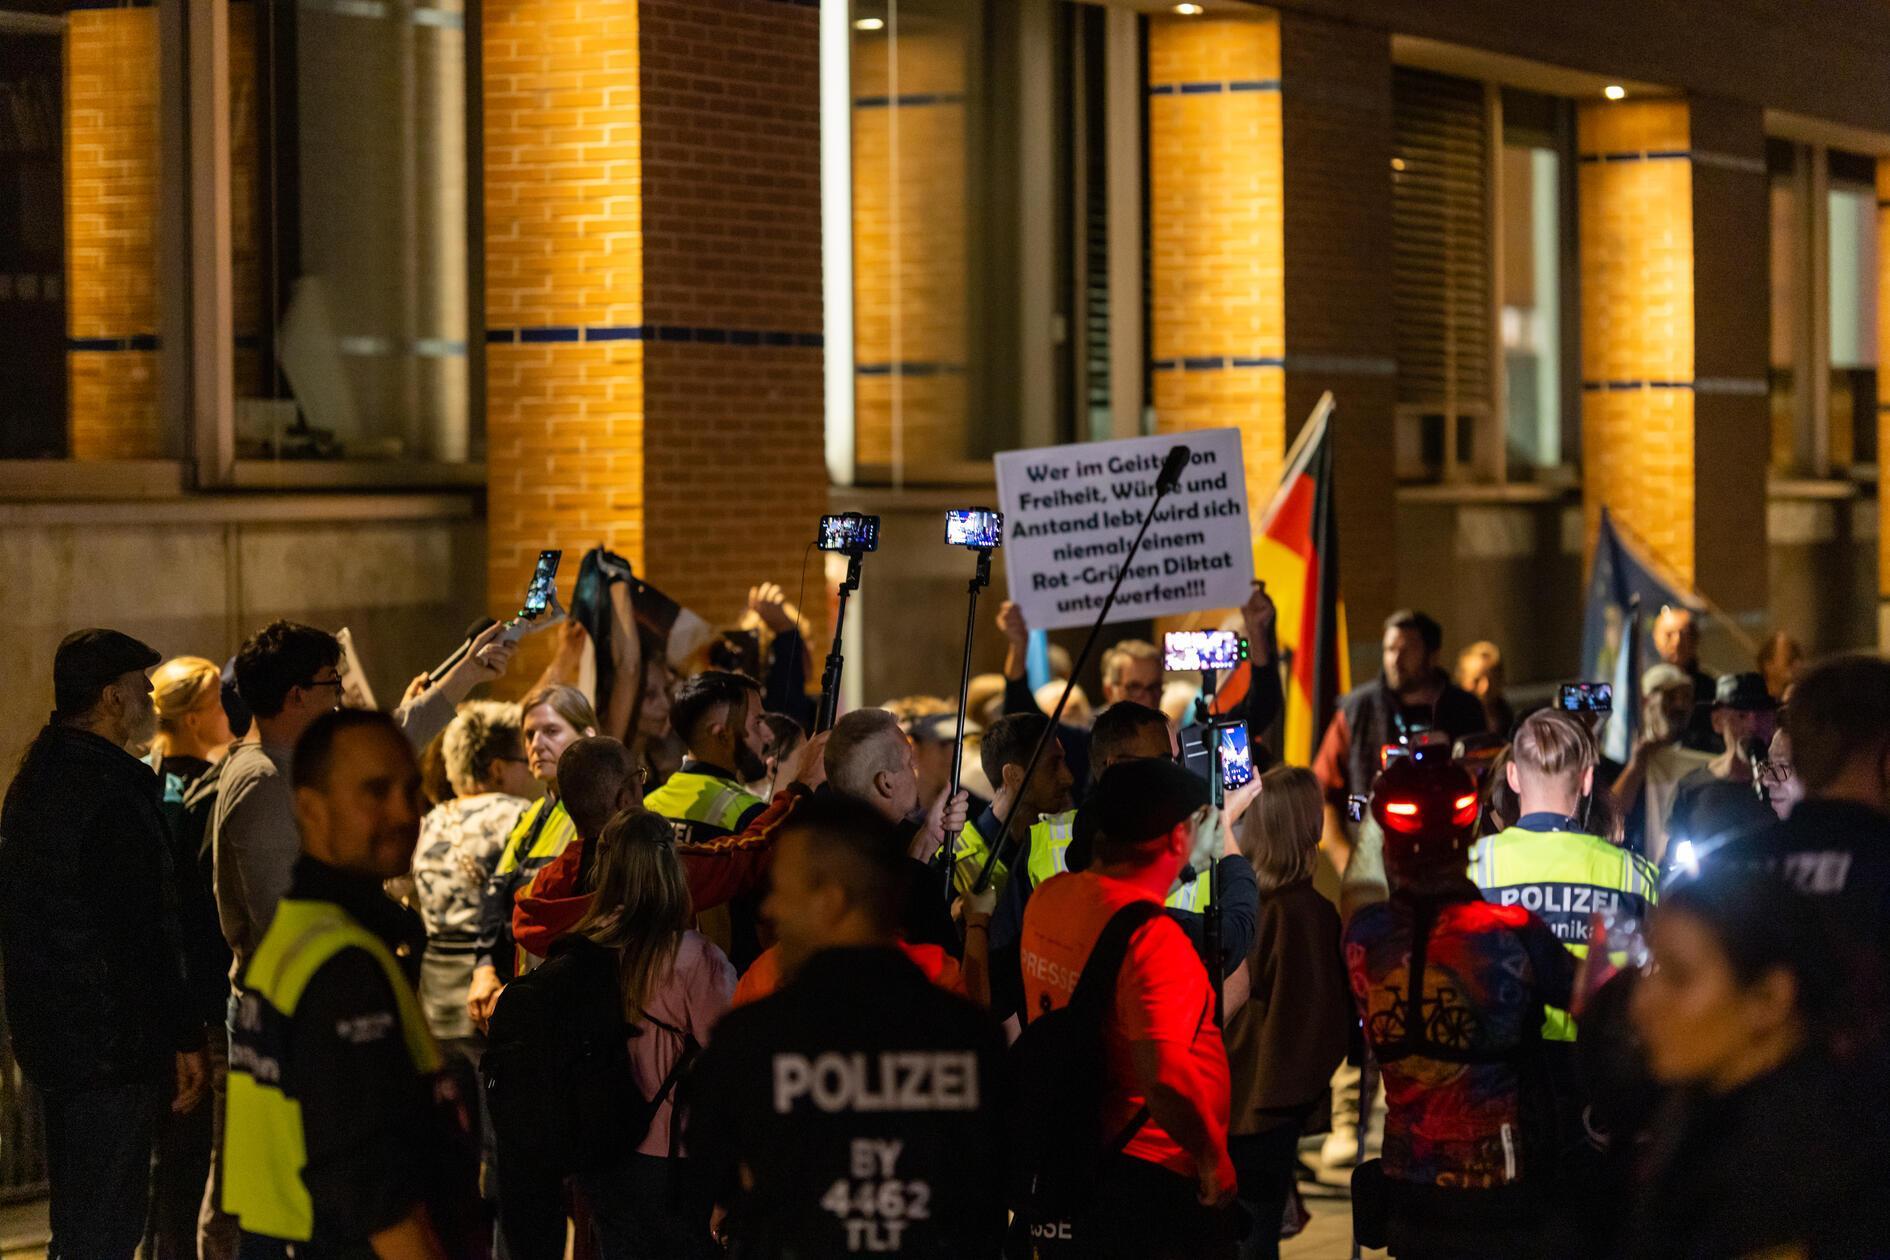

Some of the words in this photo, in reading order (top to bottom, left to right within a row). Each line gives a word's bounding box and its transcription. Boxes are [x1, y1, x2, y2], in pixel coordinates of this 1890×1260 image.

[1026, 464, 1069, 484] Wer
[1076, 458, 1103, 479] im
[1018, 488, 1107, 511] Freiheit,
[1186, 472, 1228, 493] und
[1011, 513, 1099, 539] Anstand
[1152, 501, 1200, 523] wird
[1203, 498, 1241, 519] sich
[1141, 529, 1205, 552] einem
[1163, 551, 1234, 576] Diktat
[1500, 886, 1619, 914] POLIZEI
[771, 1050, 978, 1116] POLIZEI
[850, 1137, 902, 1178] BY
